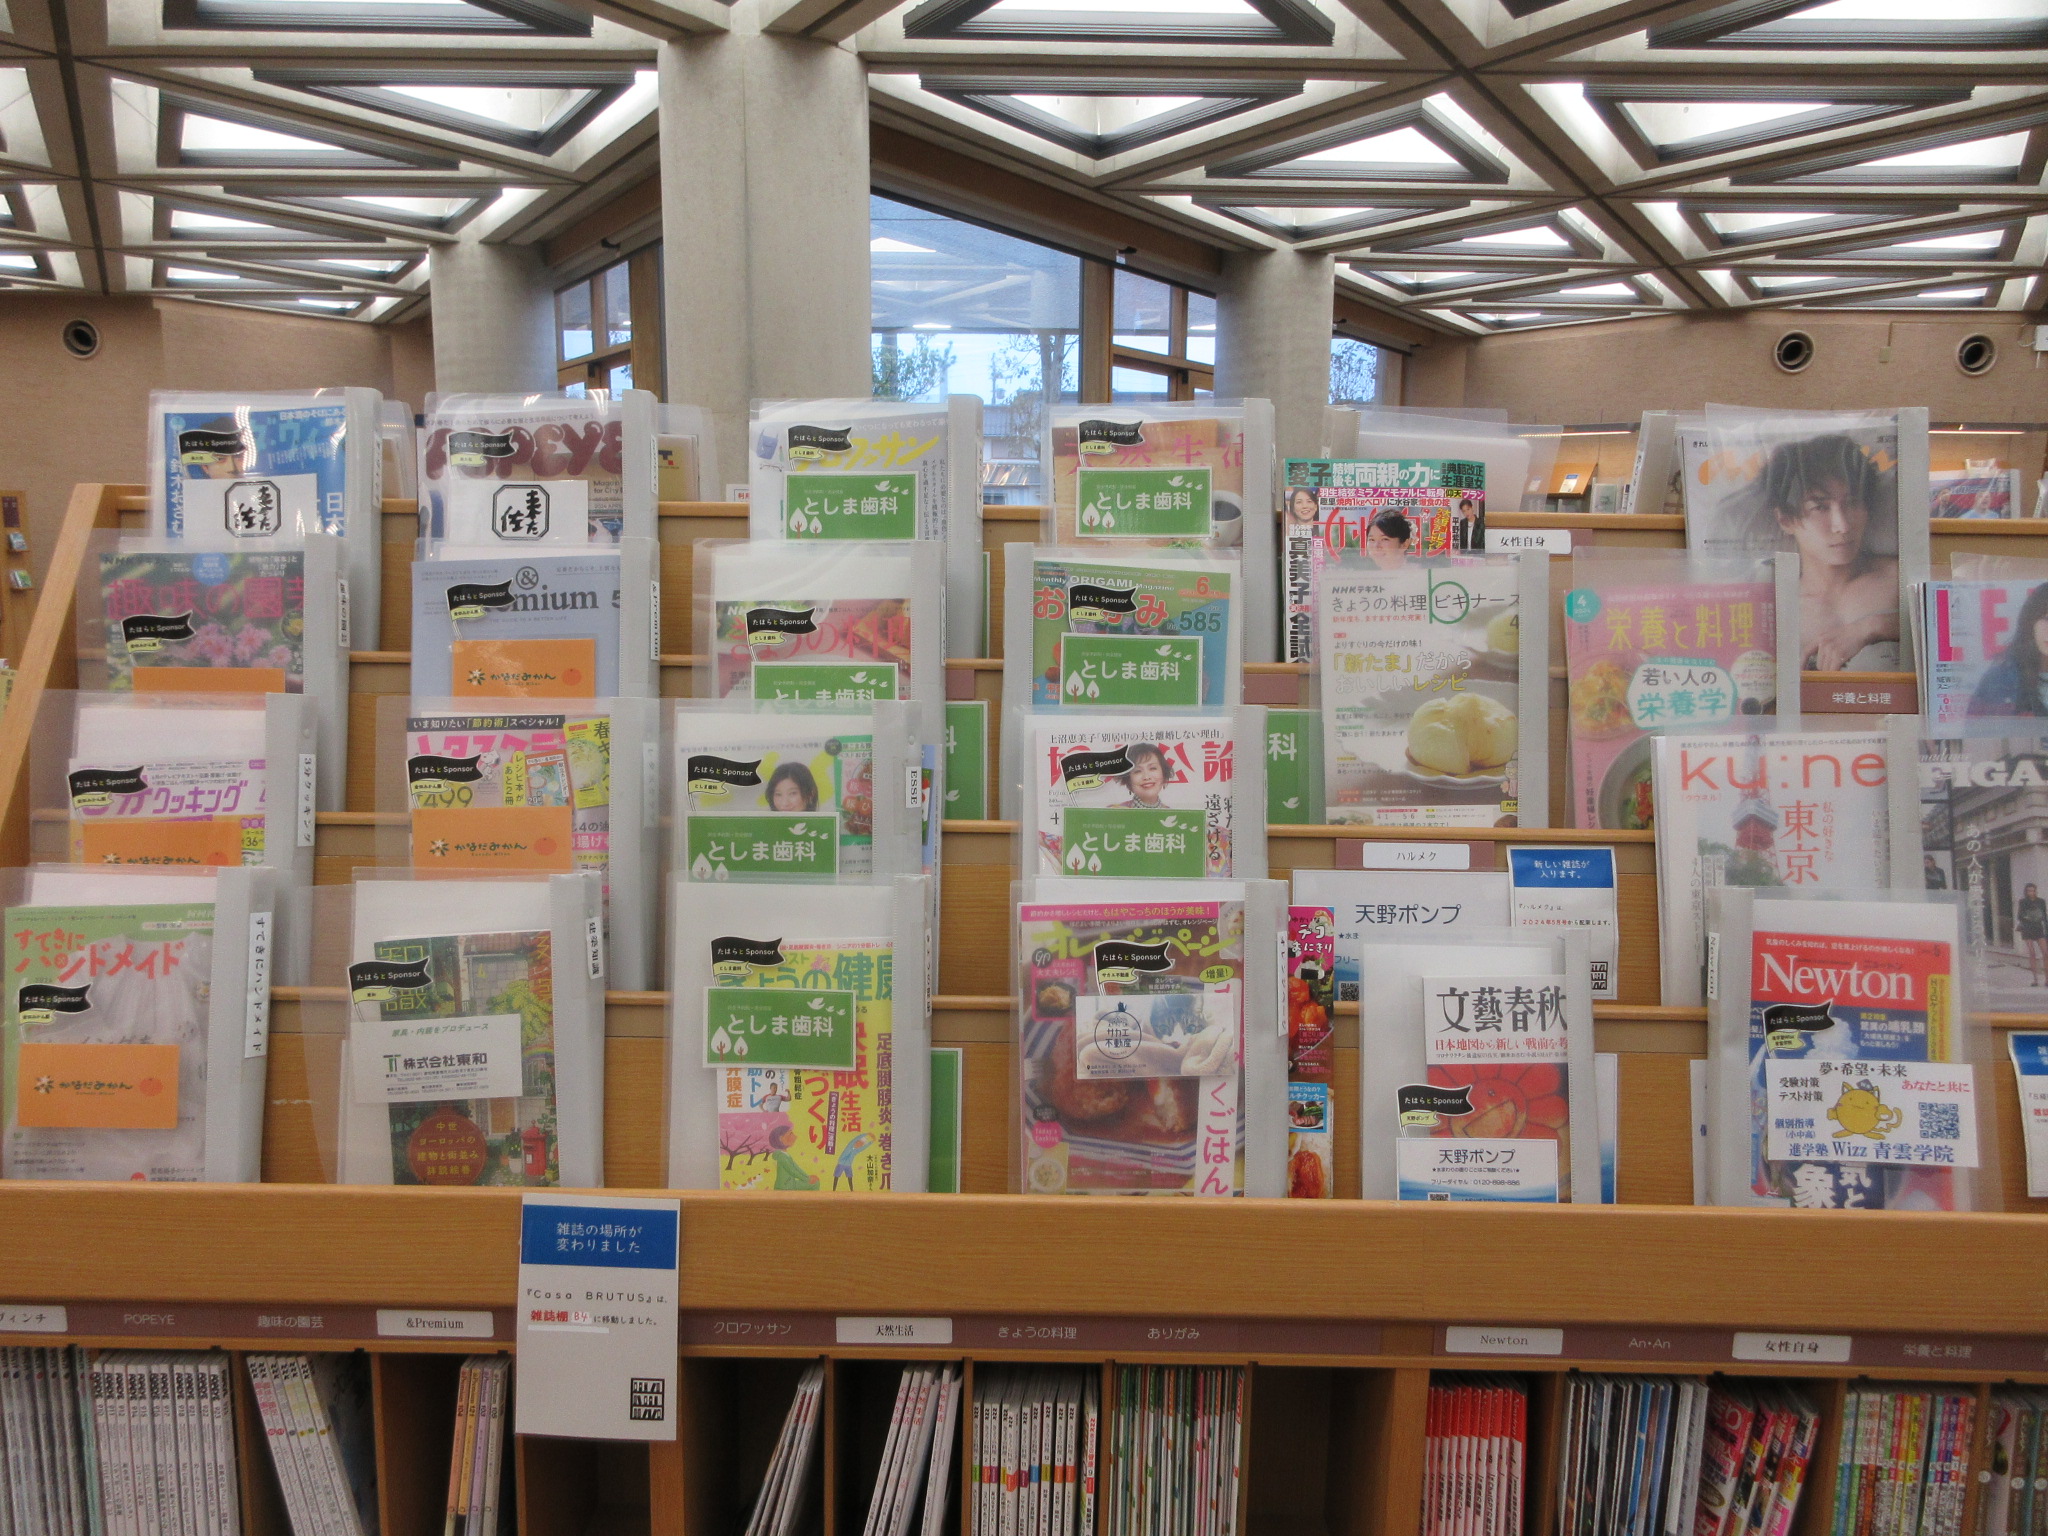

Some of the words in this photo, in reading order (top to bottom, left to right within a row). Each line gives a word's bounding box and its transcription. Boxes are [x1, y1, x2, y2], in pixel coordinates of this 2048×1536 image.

[793, 434, 817, 442] たはらと
[818, 434, 845, 443] Sponsor
[1109, 429, 1136, 437] Sponsor
[184, 439, 210, 447] たはらと
[211, 438, 237, 447] Sponsor
[454, 441, 480, 449] たはらと
[480, 441, 507, 450] Sponsor
[1288, 461, 1331, 487] 愛子
[1355, 461, 1441, 487] 両親の力に
[803, 496, 898, 516] としま歯科
[1096, 491, 1192, 510] としま歯科
[501, 505, 525, 533] 佐
[1500, 537, 1546, 548] 女性自身
[1070, 575, 1133, 589] ORIGAMI
[1196, 576, 1210, 595] 6
[453, 593, 478, 602] たはらと
[478, 590, 507, 600] Sponsor
[1332, 586, 1385, 595] NHKテキスト
[1033, 586, 1169, 628] おみ
[1075, 595, 1100, 603] たはらと
[1101, 595, 1129, 605] Sponsor
[1332, 594, 1427, 612] きょうの料理
[651, 583, 659, 658] &Premium
[752, 618, 778, 626] たはらと
[779, 618, 809, 627] Sponsor
[1179, 610, 1222, 633] 585
[1605, 602, 1754, 650] 栄養と料理
[129, 625, 156, 633] たはらと
[157, 623, 186, 633] Sponsor
[1081, 659, 1181, 681] としま歯科
[1642, 667, 1717, 687] 若い人の
[1336, 672, 1468, 695] おいしいレシピ
[1637, 687, 1728, 722] 栄養学
[1831, 691, 1892, 705] 栄養と料理
[413, 717, 560, 730] いま知りたい「節約術」スペシャル！
[1049, 729, 1226, 745] 上沼恵美子「別居中の夫と離婚しない理由」
[414, 765, 442, 775] たはらと
[443, 764, 475, 774] Sponsor
[694, 766, 720, 774] たはらと
[722, 767, 754, 777] Sponsor
[1068, 762, 1094, 773] たはらと
[1094, 757, 1124, 769] Sponsor
[514, 754, 525, 802] レシピ本が
[1919, 760, 2048, 787] FIGA
[76, 779, 104, 788] たはらと
[106, 777, 138, 787] Sponsor
[504, 765, 515, 806] あと2冊
[910, 770, 918, 805] ESSE
[303, 756, 312, 844] 3分クッキング
[1050, 812, 1060, 826] 4
[1204, 793, 1222, 862] 遠ざける
[1822, 801, 1834, 863] 私の好きな
[454, 841, 528, 851] かなだみかん
[1081, 831, 1187, 854] としま歯科
[1778, 800, 1820, 885] 東京
[708, 840, 816, 862] としま歯科
[1396, 851, 1437, 862] ハルメク
[1534, 859, 1590, 869] 新しい雑誌が
[1539, 870, 1583, 879] 入ります。
[1355, 903, 1462, 925] 天野ポンプ
[14, 927, 86, 952] すてきに
[1299, 925, 1325, 941] デコ
[588, 921, 600, 975] 建築知識
[717, 947, 745, 955] たはらと
[745, 947, 775, 956] Sponsor
[14, 941, 186, 983] ハンドメイド
[1101, 952, 1130, 962] たはらと
[1130, 952, 1162, 962] Sponsor
[356, 973, 386, 981] たはらと
[388, 970, 421, 979] Sponsor
[1206, 968, 1229, 980] 増量！
[1759, 952, 1915, 1001] Newton
[253, 916, 266, 1052] すてきにハンドメイド
[1279, 938, 1287, 1035] オレンジページ
[24, 995, 52, 1004] たはらと
[53, 995, 83, 1003] Sponsor
[1436, 984, 1568, 1034] 文藝春秋
[727, 1014, 834, 1038] としま歯科
[1796, 1014, 1825, 1024] Sponsor
[1106, 1028, 1130, 1038] サカエ
[1105, 1039, 1132, 1049] 不動産
[403, 1052, 488, 1071] 株式会社東和
[1819, 1061, 1908, 1077] 夢・希望・未来
[59, 1080, 133, 1091] かなだみかん
[1778, 1076, 1820, 1088] 受験対策
[1901, 1079, 1971, 1093] あなたと共に
[1404, 1096, 1432, 1105] たはらと
[1433, 1097, 1464, 1106] Sponsor
[1778, 1090, 1824, 1102] テスト対策
[436, 1121, 458, 1131] 中世
[1774, 1117, 1815, 1129] 個別指導
[419, 1135, 476, 1146] ヨーロッパの
[1439, 1149, 1516, 1164] 天野ポンプ
[1788, 1141, 1830, 1158] 進学塾
[1832, 1141, 1868, 1158] Wizz
[1873, 1142, 1955, 1163] 青雲学院
[556, 1222, 643, 1238] 雑誌の場所が
[556, 1239, 641, 1254] 変わりました
[124, 1313, 175, 1326] POPEYE
[257, 1315, 324, 1329] 趣味の園芸
[406, 1317, 464, 1330] &Premium
[530, 1310, 569, 1323] 雑誌棚
[593, 1315, 658, 1327] に移動しました。
[713, 1321, 792, 1335] クロワッサン
[875, 1324, 915, 1337] 天然生活
[998, 1326, 1078, 1340] きょうの料理
[1147, 1327, 1201, 1340] おりがみ
[1480, 1334, 1529, 1346] Newton
[1764, 1340, 1819, 1354] 女性自身
[1903, 1343, 1973, 1360] 栄養と料理
